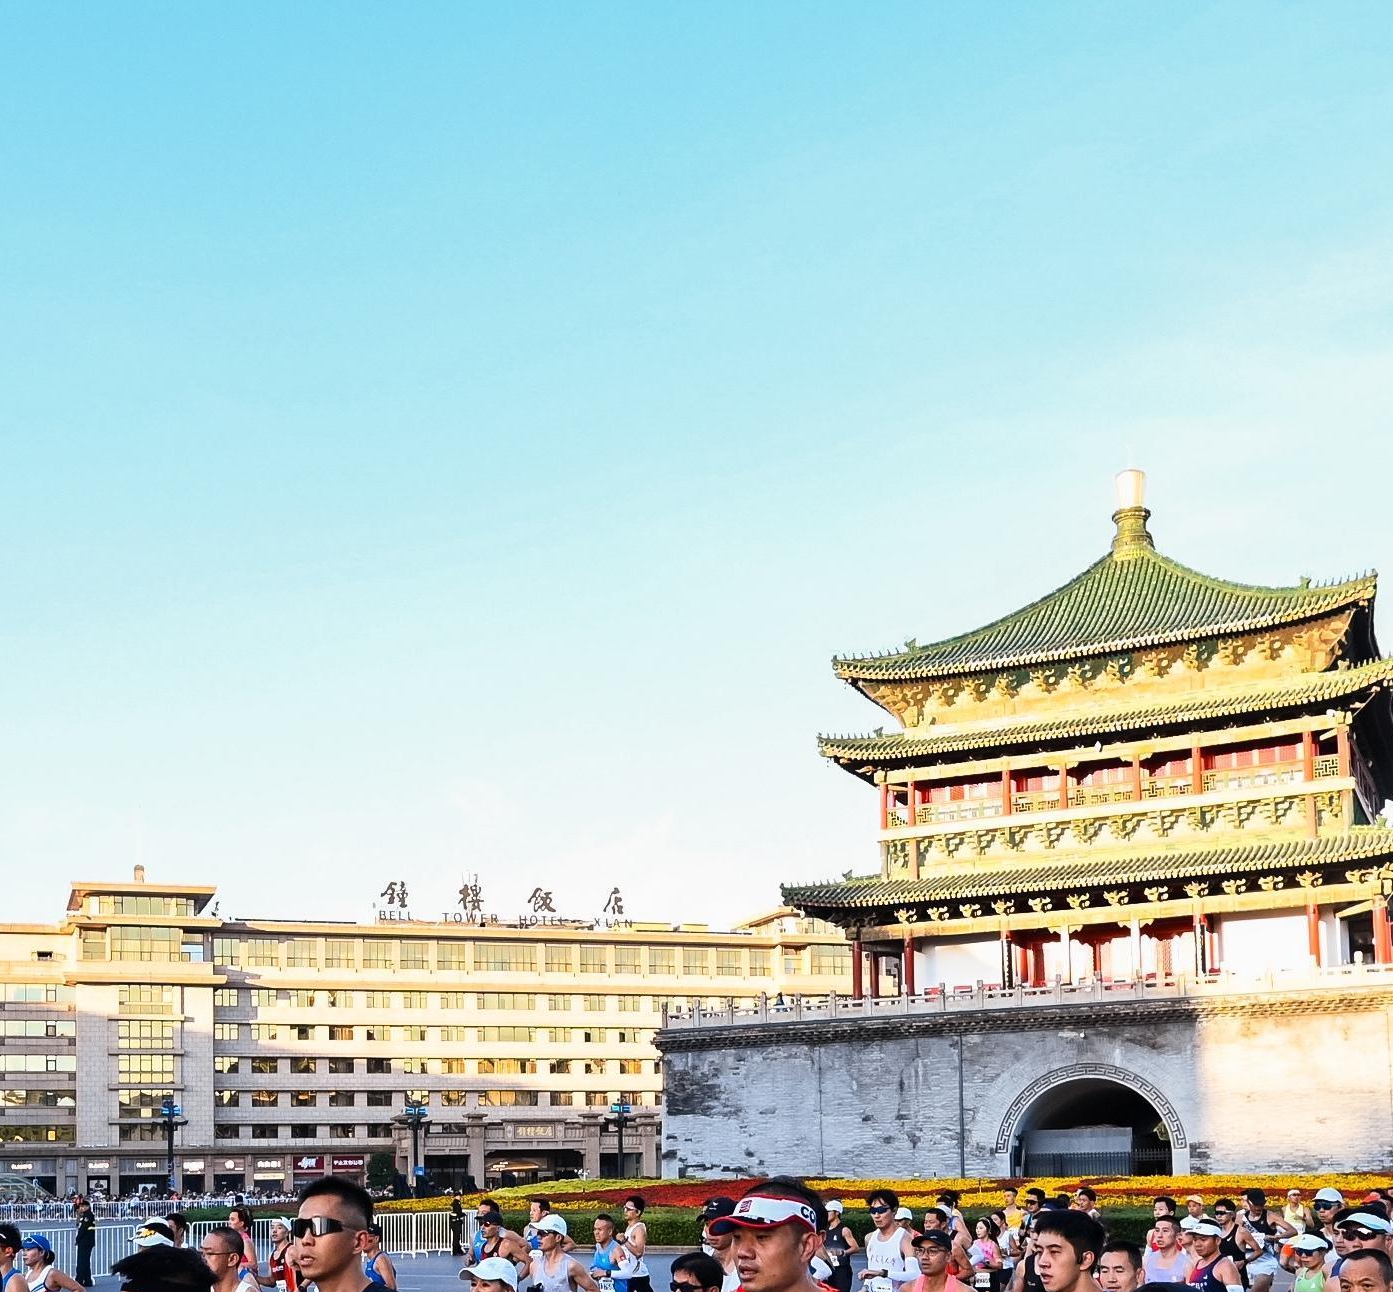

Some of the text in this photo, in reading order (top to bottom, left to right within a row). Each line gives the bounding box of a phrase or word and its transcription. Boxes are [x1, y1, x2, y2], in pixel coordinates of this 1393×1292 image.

[379, 910, 415, 921] BELL
[442, 912, 499, 924] TOWER
[519, 915, 567, 928] HOTEL
